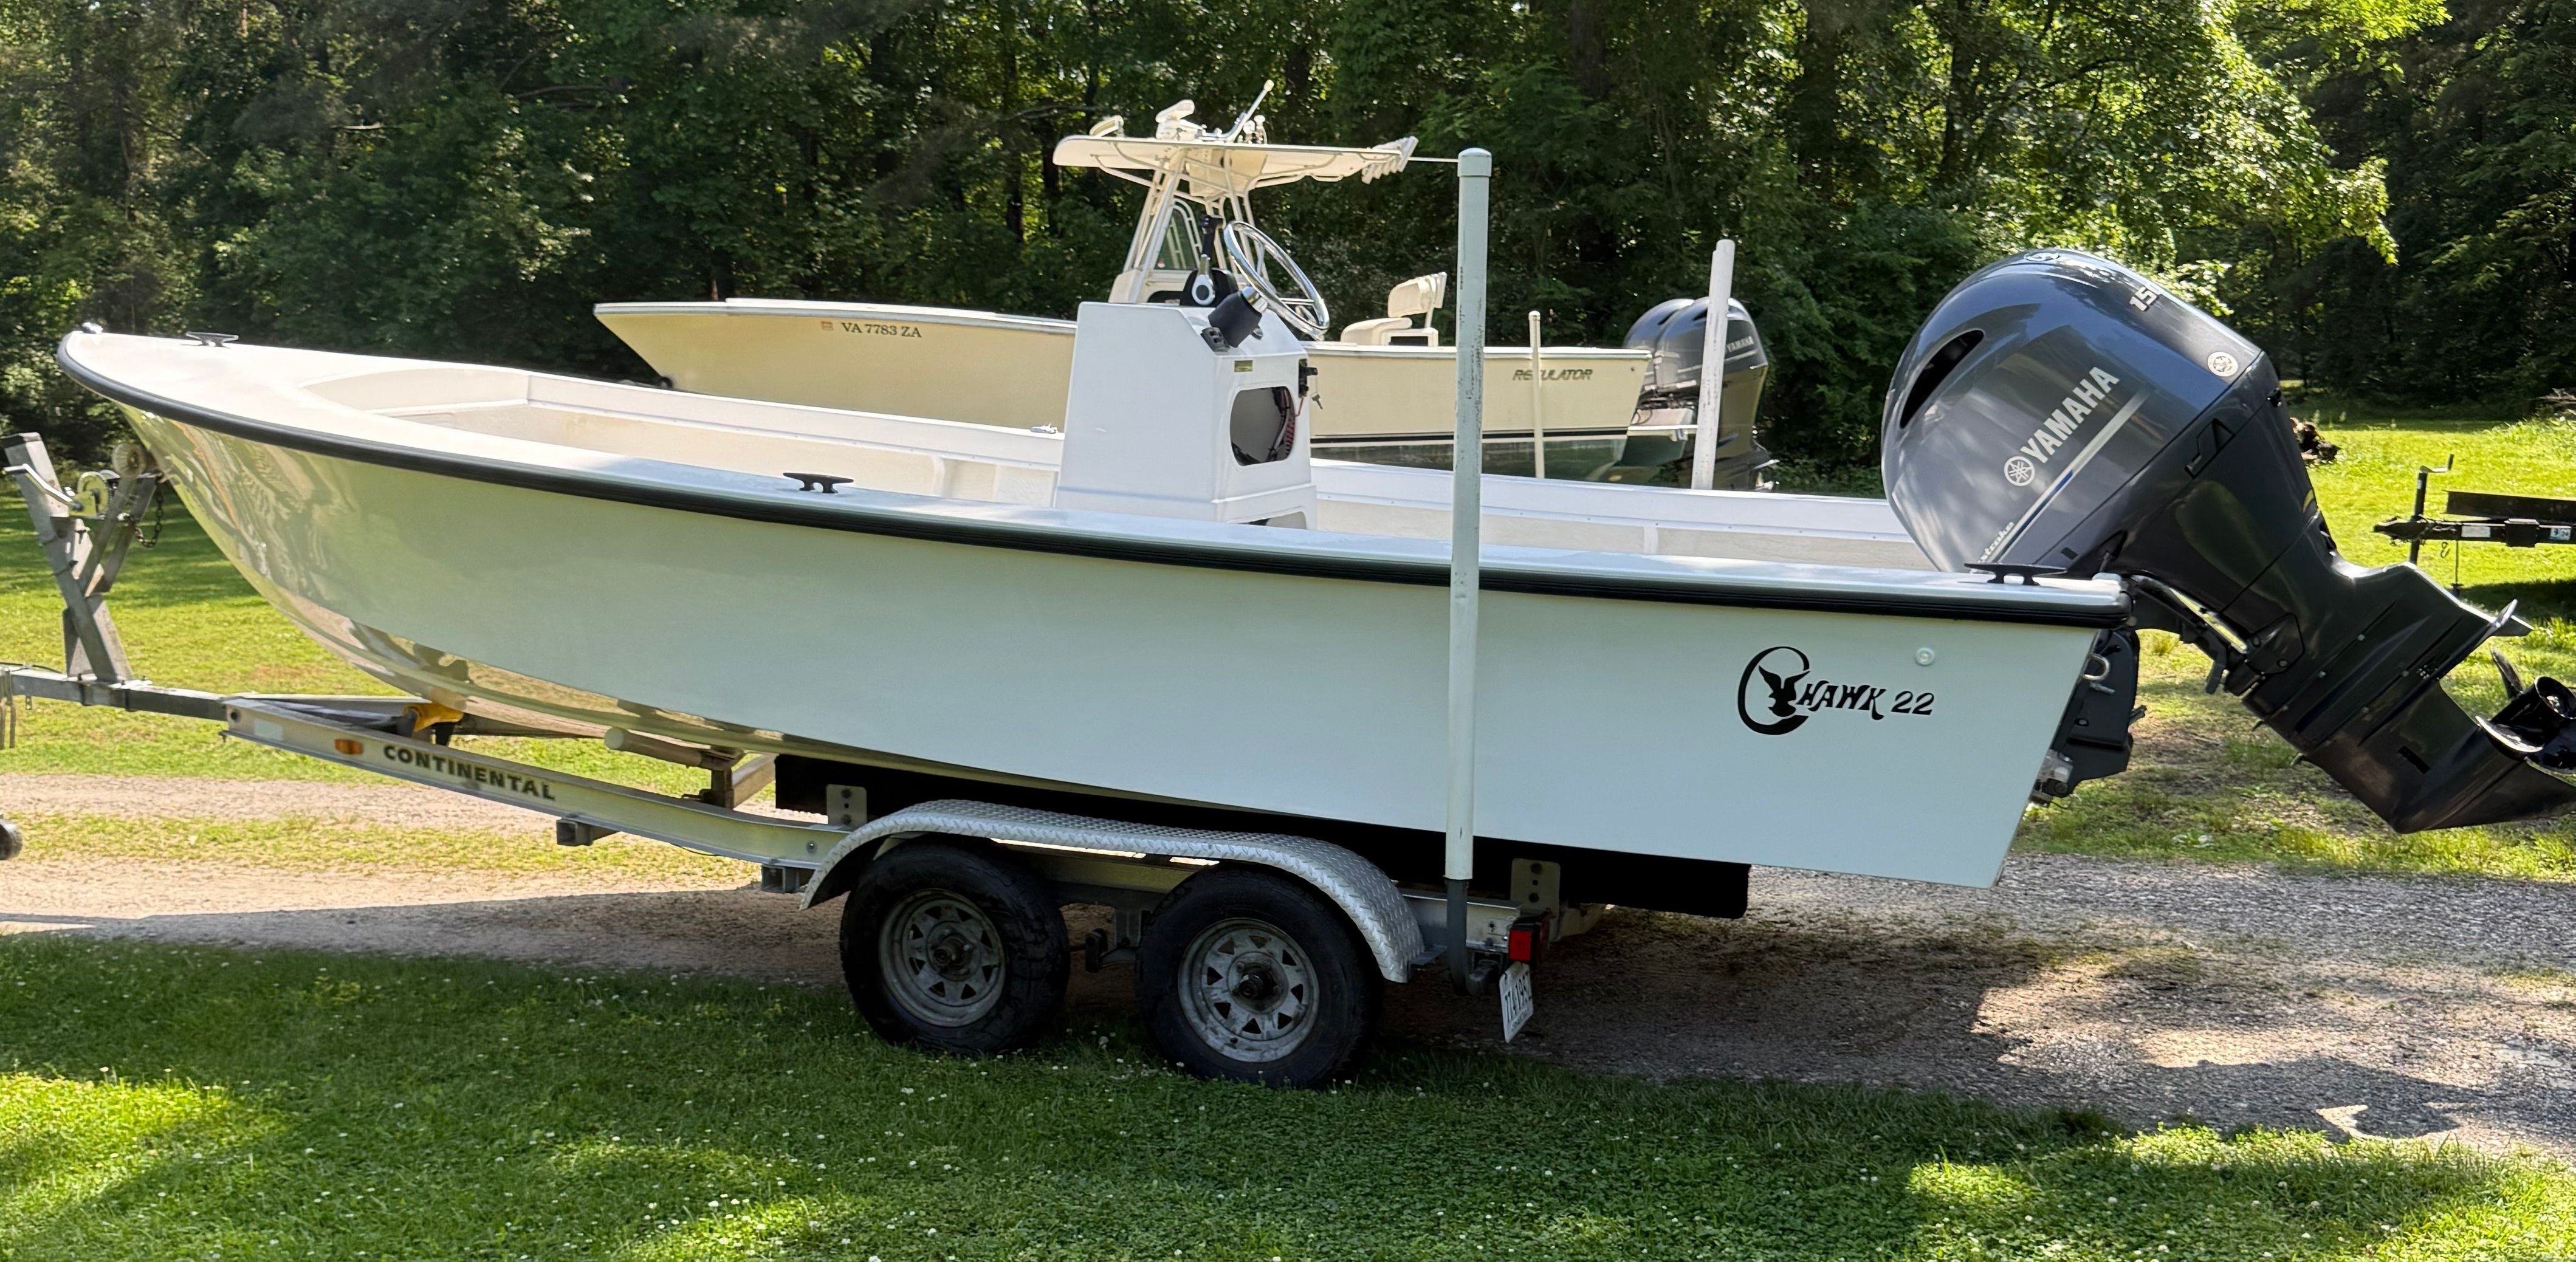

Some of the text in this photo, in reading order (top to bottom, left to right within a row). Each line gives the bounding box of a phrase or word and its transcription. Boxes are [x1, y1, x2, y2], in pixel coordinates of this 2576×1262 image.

[841, 322, 922, 338] VA 7783 ZA
[1726, 335, 1754, 353] YAMAHA
[1512, 368, 1593, 381] REULATOR
[2020, 366, 2120, 464] YAMAHA
[1796, 680, 1886, 721] HAWK
[1891, 690, 1935, 716] 22
[383, 744, 555, 801] CONTINENTAL
